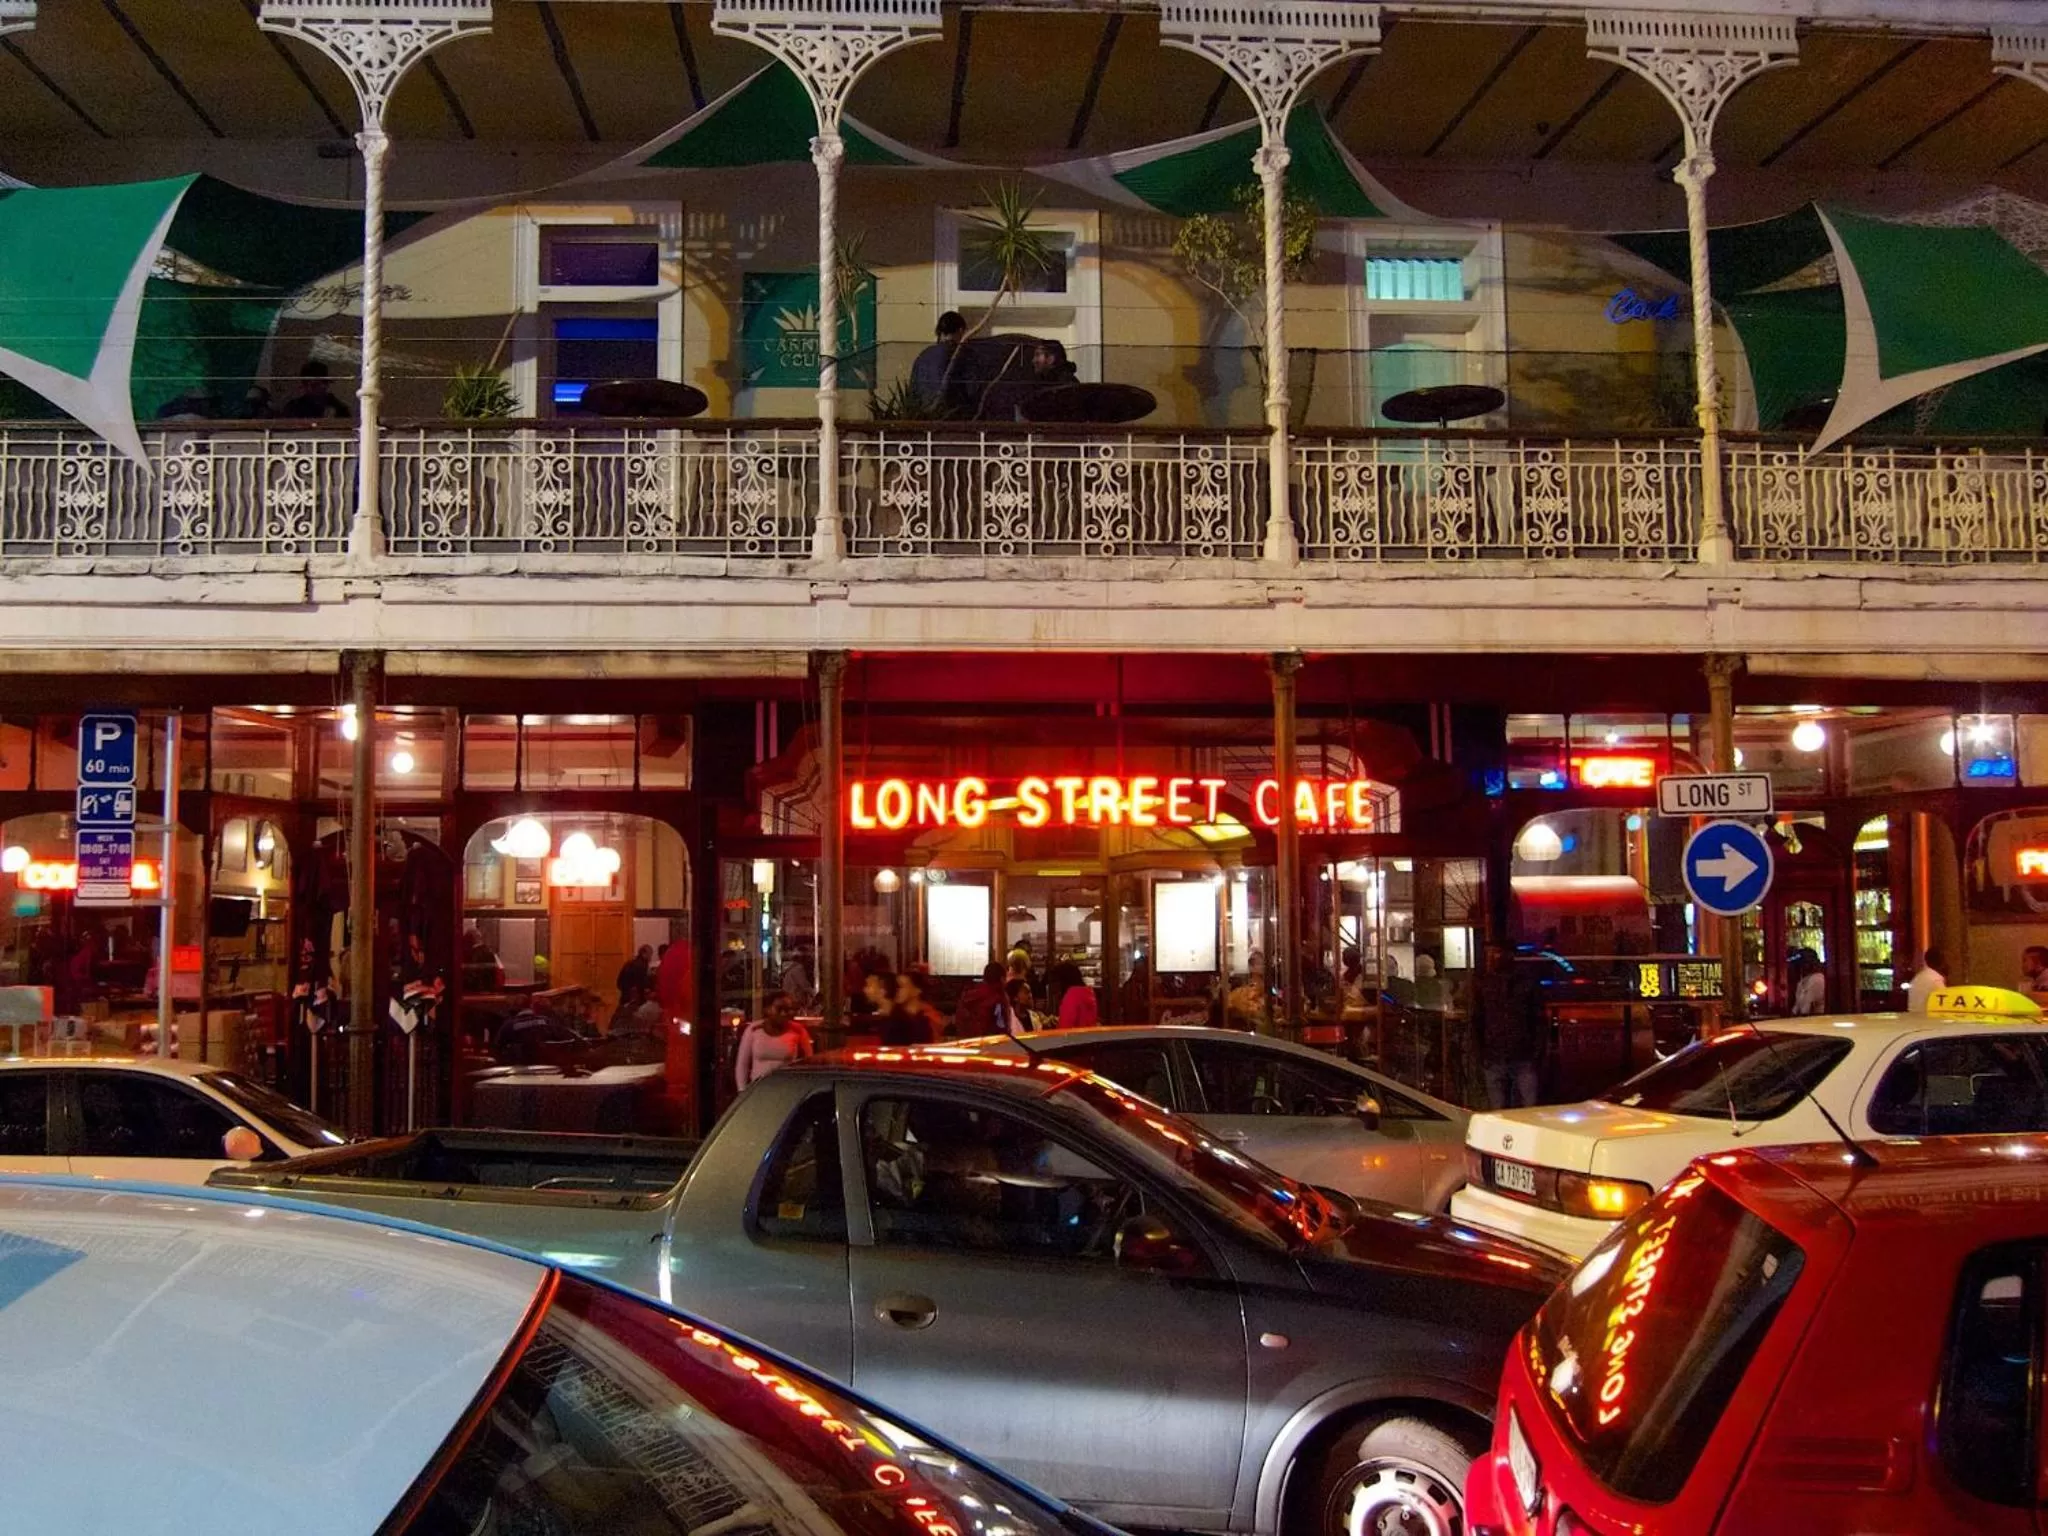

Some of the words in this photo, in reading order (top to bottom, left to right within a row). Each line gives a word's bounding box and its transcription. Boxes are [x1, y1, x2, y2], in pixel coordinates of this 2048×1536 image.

[95, 722, 121, 750] P
[85, 759, 105, 773] 60
[109, 764, 130, 773] min
[851, 777, 988, 829] LONG
[1016, 777, 1227, 827] STREET
[1255, 779, 1373, 827] CAFE
[1676, 783, 1730, 807] LONG
[1738, 782, 1752, 796] ST
[1936, 994, 1998, 1009] TAXI
